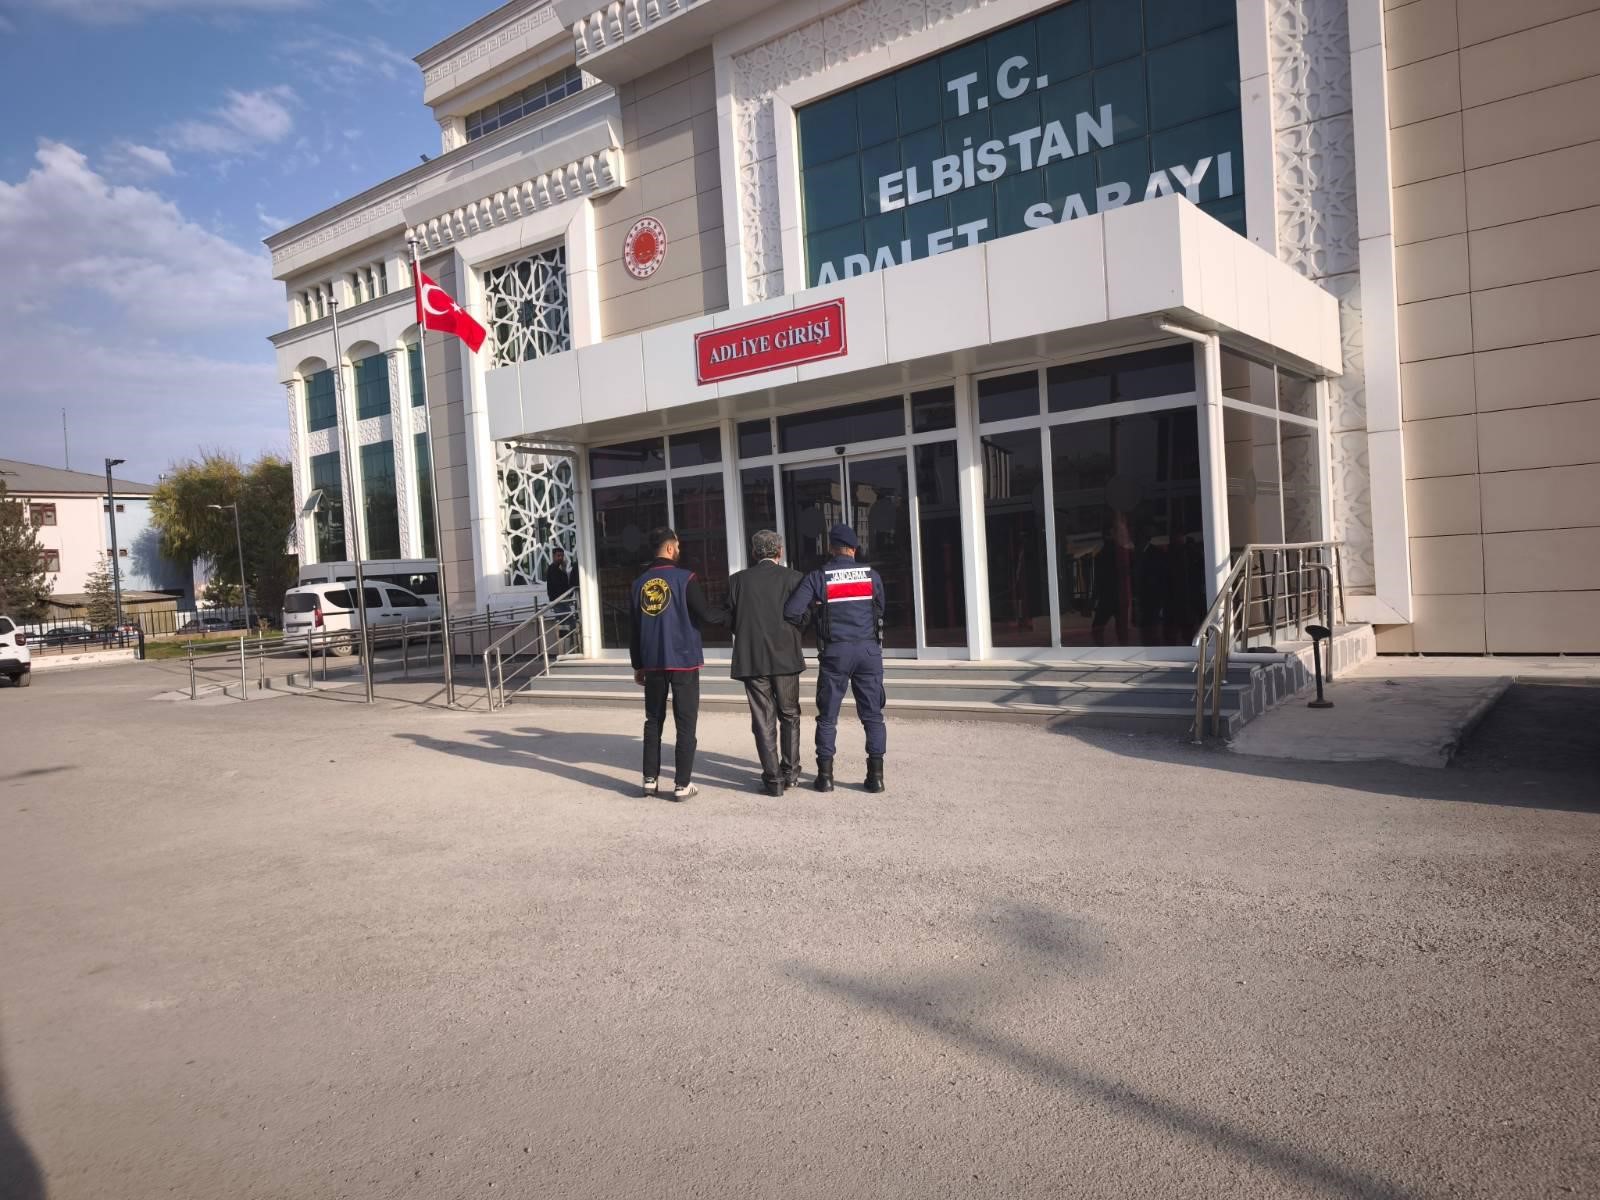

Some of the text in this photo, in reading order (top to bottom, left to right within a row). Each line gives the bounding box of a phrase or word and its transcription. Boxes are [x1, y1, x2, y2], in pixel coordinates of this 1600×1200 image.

[878, 104, 1114, 213] ELBİSTAN
[709, 316, 831, 364] ADLİYE GİRİŞİ
[831, 570, 868, 581] JANDARMA
